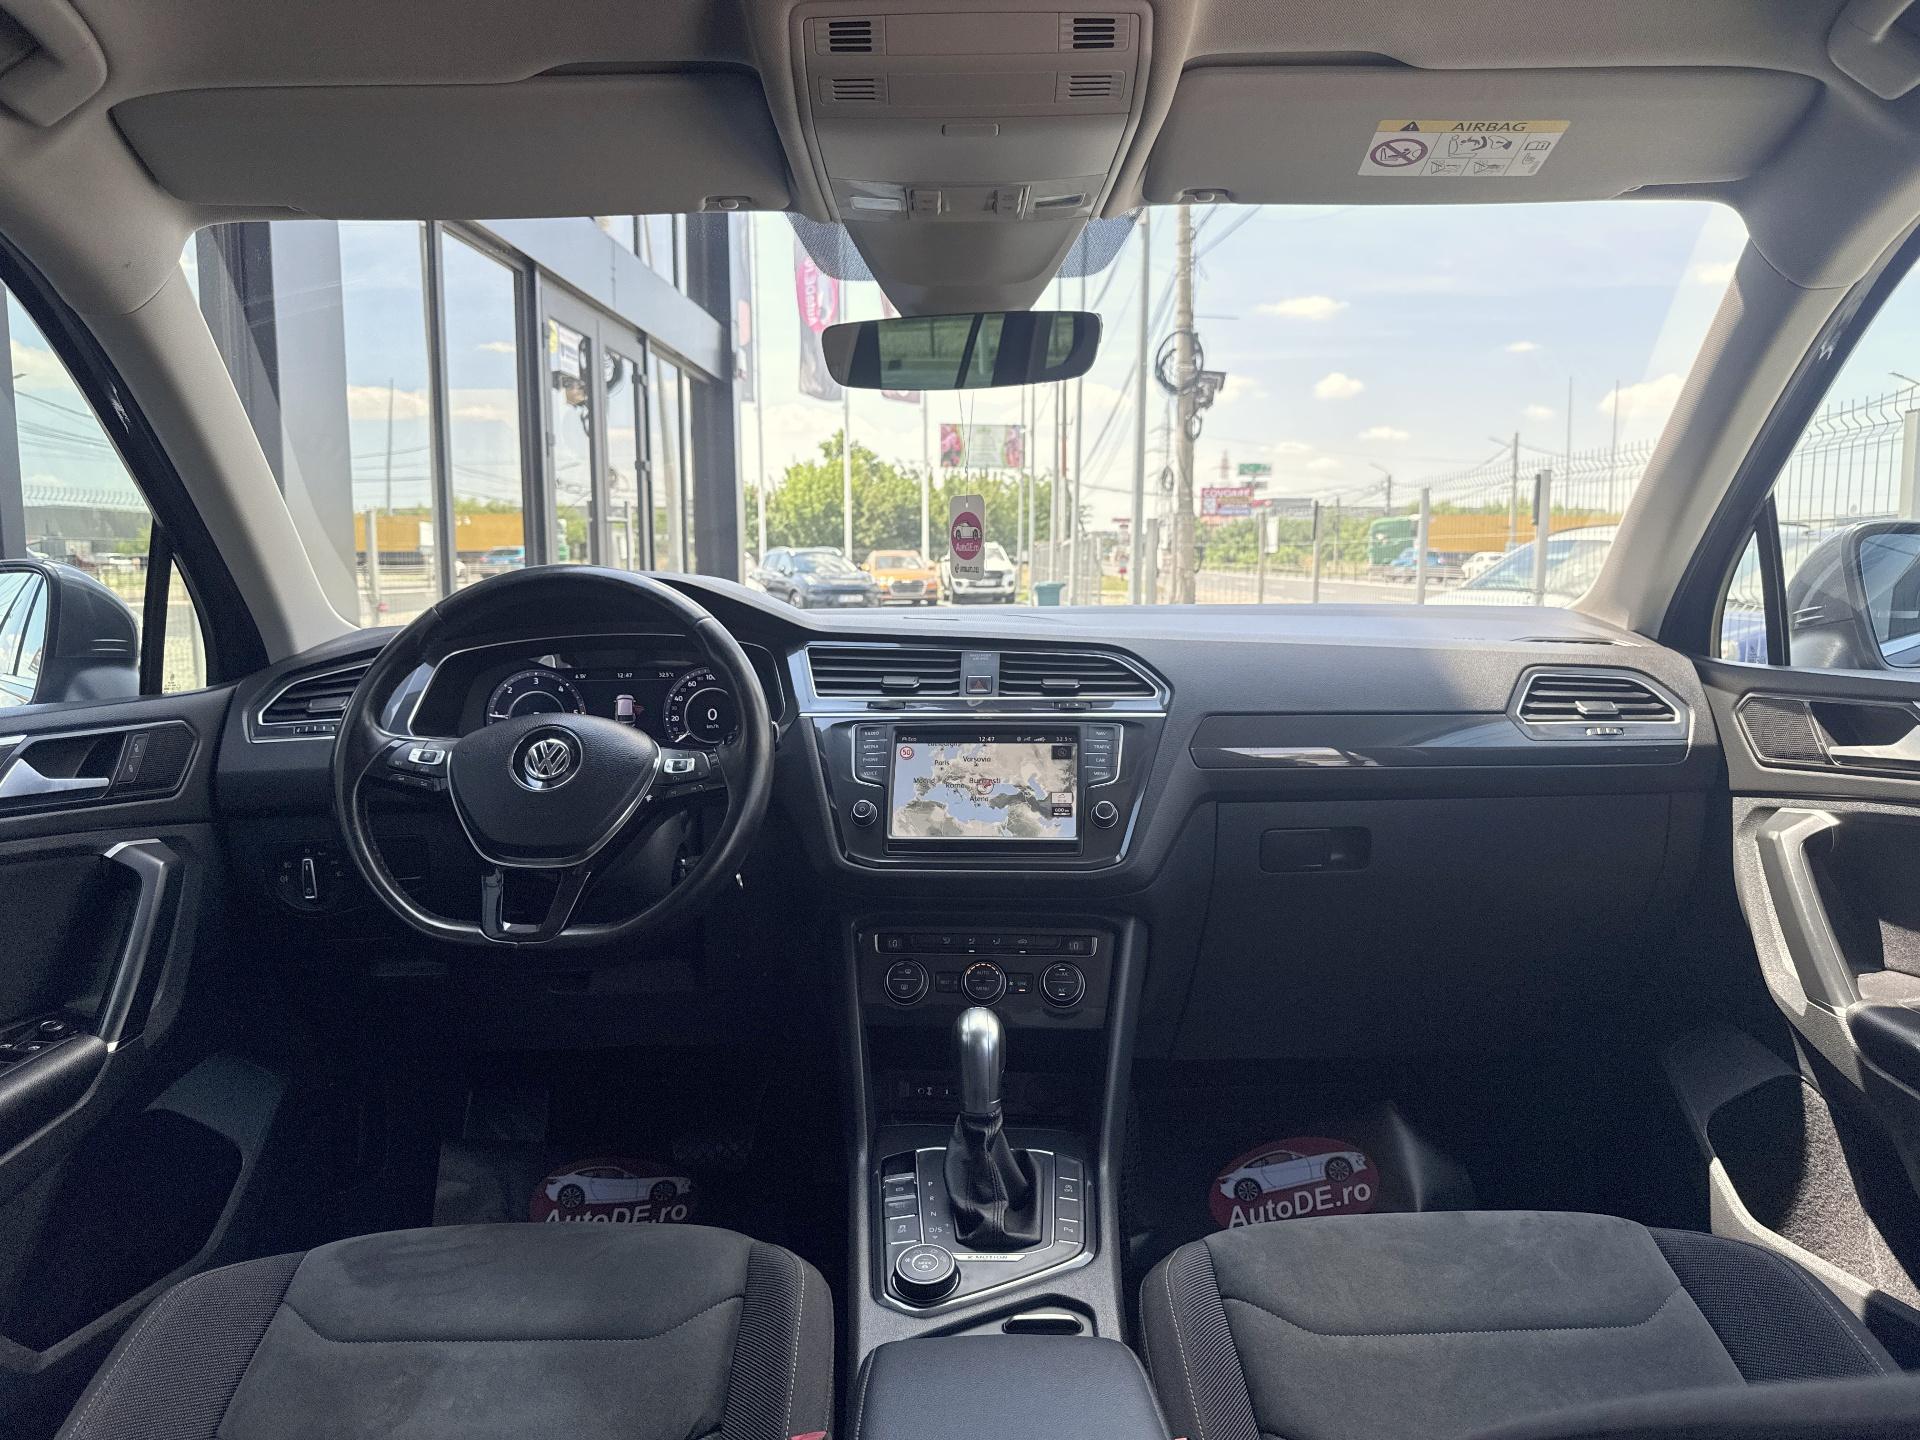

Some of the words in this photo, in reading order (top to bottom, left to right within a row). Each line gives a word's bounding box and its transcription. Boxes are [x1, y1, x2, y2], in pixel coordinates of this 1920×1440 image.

[1451, 122, 1527, 132] AIRBAG
[707, 708, 718, 721] 0
[1228, 1182, 1371, 1228] AutoDE.ro
